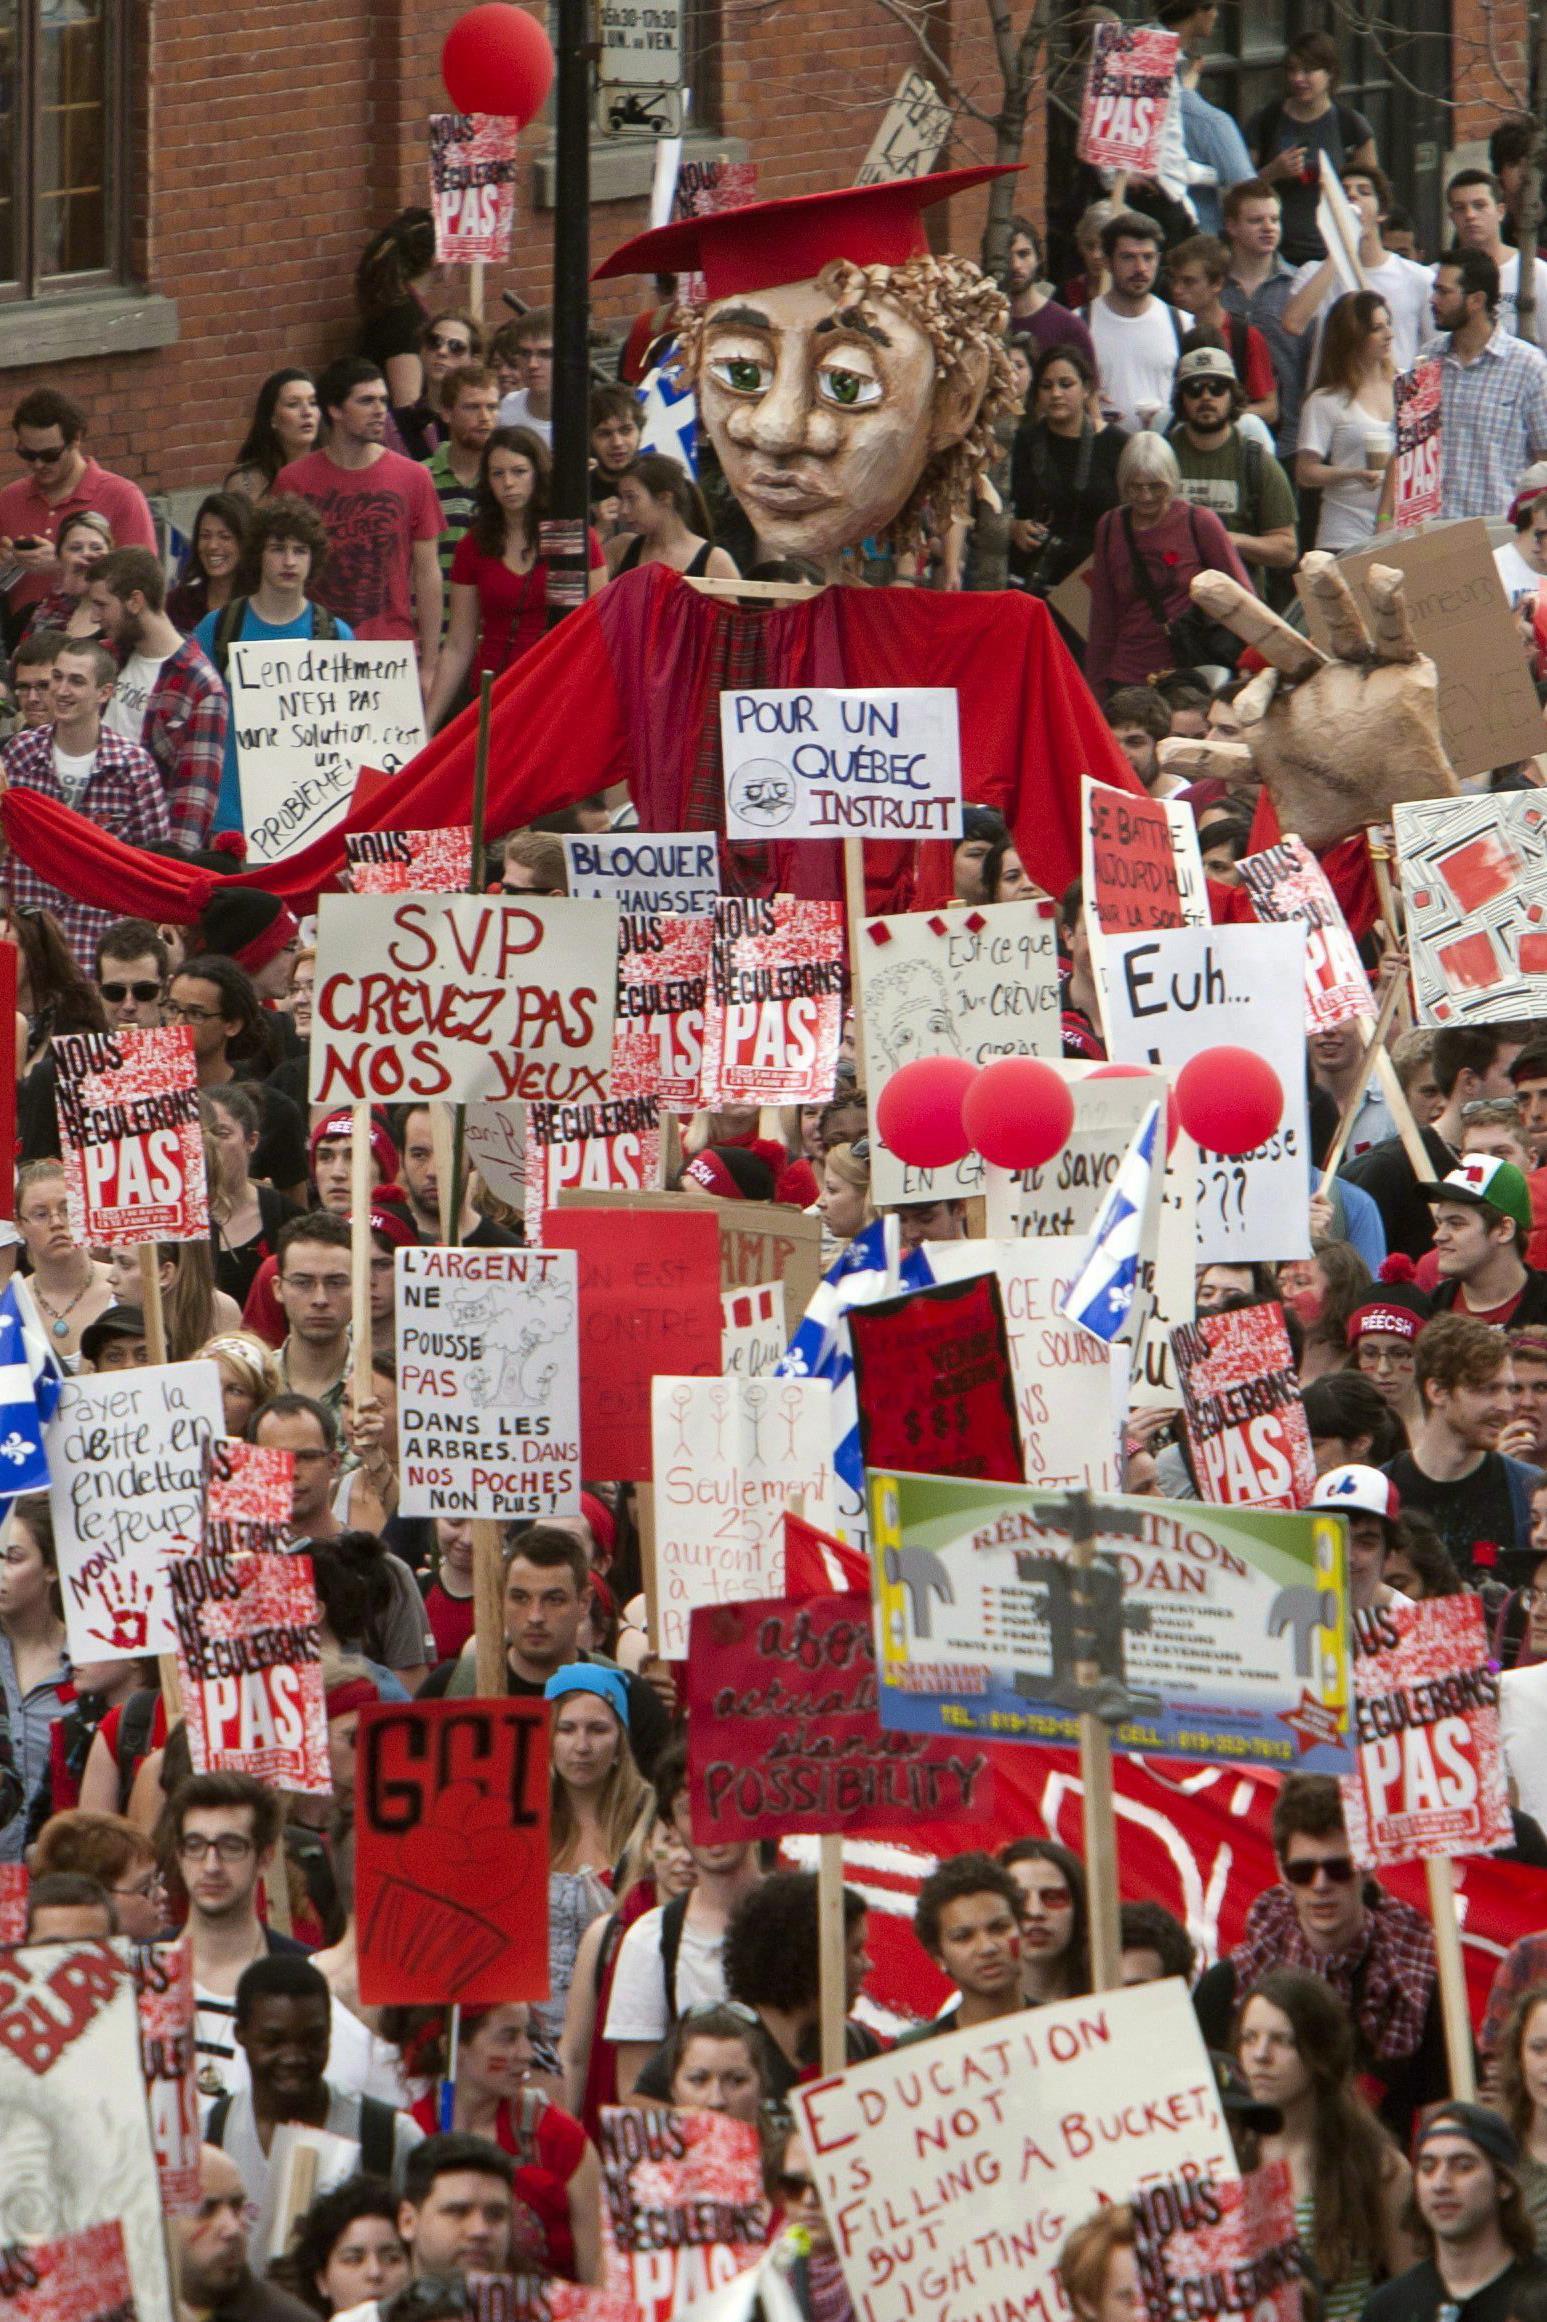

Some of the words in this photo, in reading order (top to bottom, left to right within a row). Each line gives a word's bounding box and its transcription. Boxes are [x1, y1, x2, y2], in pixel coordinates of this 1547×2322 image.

[1092, 96, 1154, 147] PAS
[441, 183, 499, 235] PAS
[349, 690, 381, 712] PAS
[735, 695, 820, 734] POUR
[840, 701, 900, 738] UN
[314, 751, 340, 767] un
[791, 743, 931, 790] QUÉBEC
[808, 789, 956, 831] INSTRUIT
[570, 842, 715, 879] BLOQUER
[1123, 943, 1250, 1018] Euh...
[508, 985, 598, 1048] PAS
[724, 997, 818, 1069] PAS
[314, 1040, 452, 1102] NOS
[84, 1128, 182, 1209] PAS
[547, 1133, 642, 1209] PAS
[403, 1250, 559, 1282] L'ARGENT
[404, 1285, 441, 1309] NE
[403, 1328, 483, 1361] POUSSE
[56, 1382, 142, 1422] Payer
[162, 1381, 191, 1412] la
[401, 1365, 458, 1398] PAS
[403, 1409, 480, 1435] DANS
[499, 1416, 551, 1436] LES
[404, 1437, 517, 1463] ARBRES.
[523, 1440, 579, 1464] DANS
[1203, 1414, 1293, 1505] PAS
[407, 1466, 454, 1487] NOS
[471, 1468, 573, 1495] POCHES
[429, 1489, 478, 1512] NON
[492, 1493, 541, 1514] PLUS
[665, 1463, 829, 1507] Seulement
[75, 1502, 106, 1543] le
[663, 1541, 767, 1572] auront
[204, 1664, 302, 1750] PAS
[1355, 1666, 1500, 1743] ECULERONS
[704, 1754, 986, 1821] POSSIBILITY
[1364, 1715, 1479, 1821] PAS
[801, 2009, 1112, 2156] EDUCATION
[829, 2157, 872, 2199] IS
[915, 2088, 1007, 2158] NOT
[836, 2151, 1001, 2257] FILLING
[1020, 2137, 1056, 2182] A
[1061, 2085, 1220, 2160] BUCKET,
[866, 2219, 944, 2287] BUT
